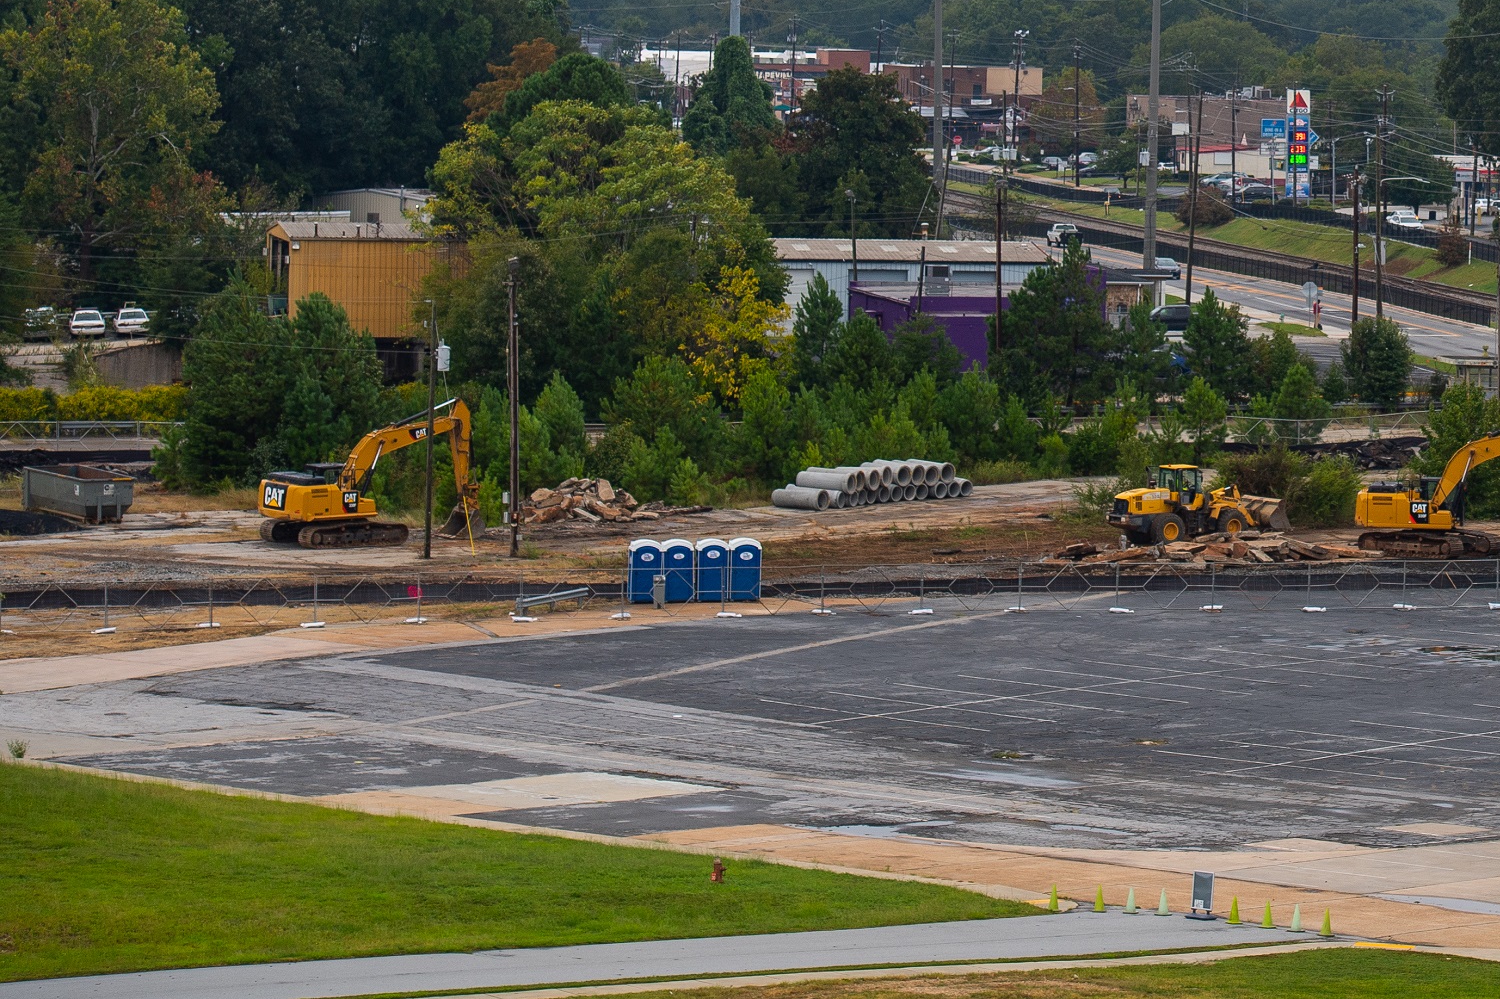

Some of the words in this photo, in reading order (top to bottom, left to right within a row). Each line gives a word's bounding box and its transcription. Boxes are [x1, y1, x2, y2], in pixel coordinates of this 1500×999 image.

[415, 427, 427, 439] CAT
[264, 486, 285, 508] CAT
[344, 493, 357, 503] CAT
[1412, 503, 1428, 513] CAT
